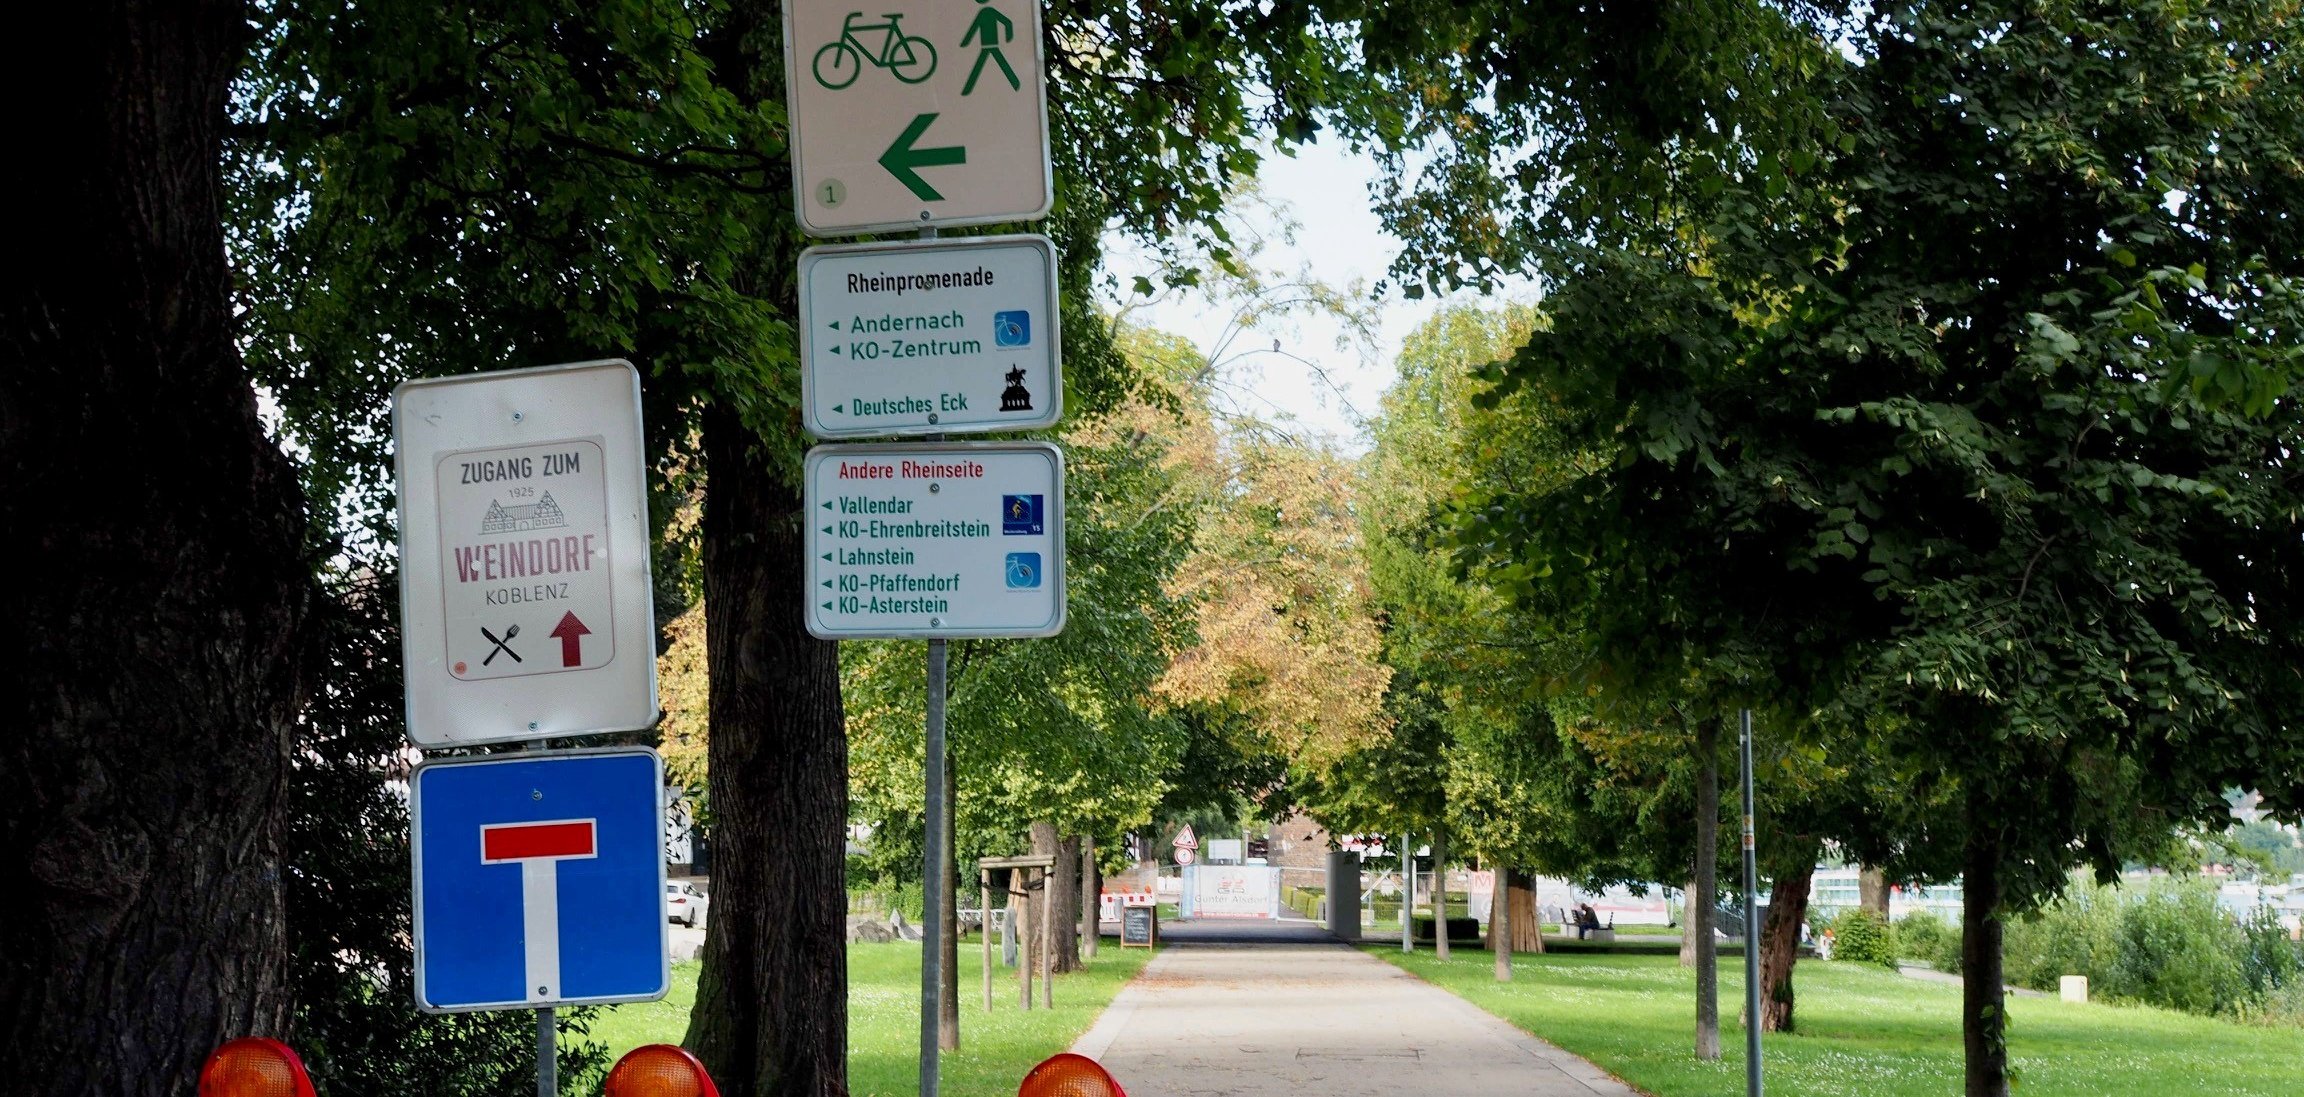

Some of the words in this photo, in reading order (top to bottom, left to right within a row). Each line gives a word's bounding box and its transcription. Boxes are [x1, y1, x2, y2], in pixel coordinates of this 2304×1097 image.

[826, 186, 836, 204] 1
[847, 266, 994, 296] Rheinpromenade
[851, 310, 964, 334] Andernach
[851, 339, 981, 360] KO-Zentrum
[853, 396, 932, 416] Deutsches
[941, 393, 968, 412] Eck
[461, 457, 533, 485] ZUGANG
[543, 452, 580, 478] ZUM
[839, 461, 893, 479] Andere
[902, 460, 983, 479] Rheinseite
[508, 487, 535, 498] 1925
[839, 496, 913, 514] Vallendar
[839, 519, 990, 538] KO-Ehrenbreitstein
[454, 534, 595, 583] WEINDORF
[839, 547, 914, 565] Lahnstein
[839, 573, 960, 592] KO-Pfaffendorf
[486, 583, 569, 606] KOBLENZ
[839, 595, 948, 614] KO-Asterstein
